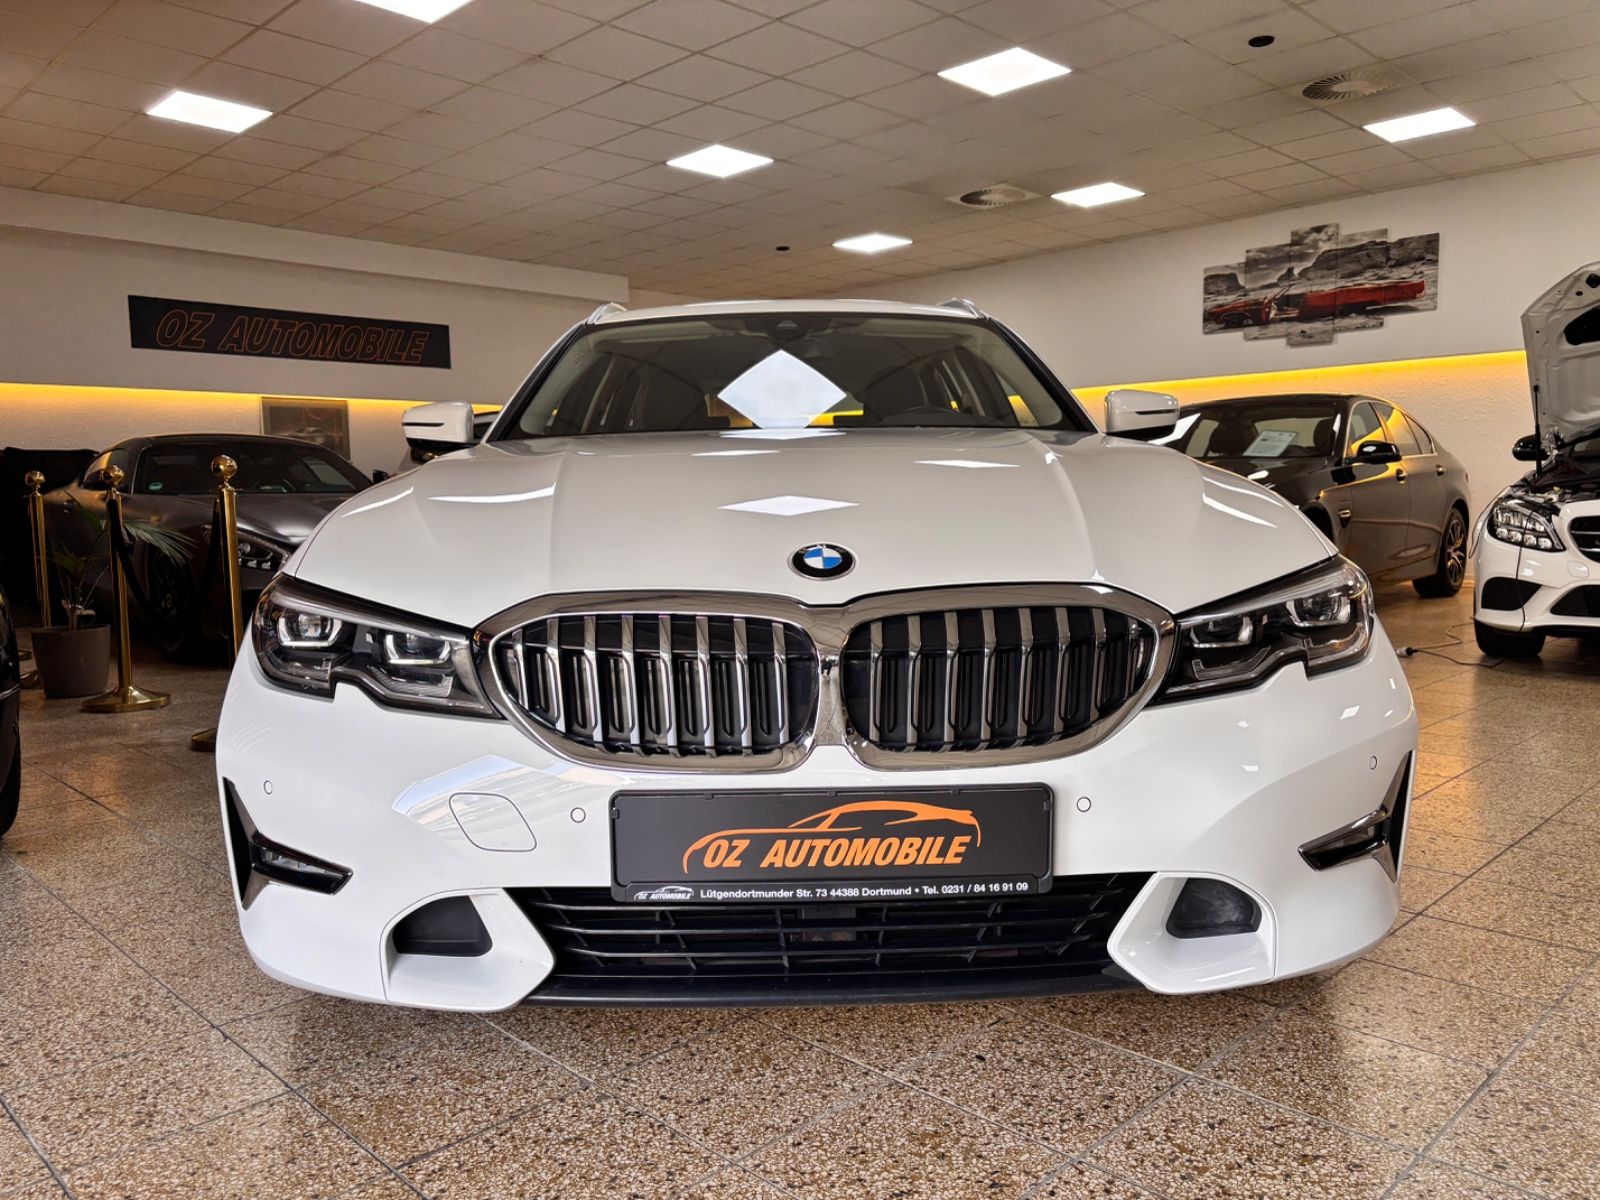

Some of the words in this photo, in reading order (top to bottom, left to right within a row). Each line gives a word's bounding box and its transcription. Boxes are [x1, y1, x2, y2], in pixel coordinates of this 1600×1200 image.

[156, 309, 215, 349] OZ
[217, 316, 430, 365] AUTOMOBILE
[703, 839, 751, 868] OZ
[760, 836, 972, 868] AUTOMOBILE
[649, 892, 692, 900] AUTOMOBILE
[700, 888, 793, 900] Lütgendortmunder
[796, 888, 813, 898] Str.
[815, 888, 828, 897] 73
[829, 888, 859, 897] 44388
[862, 887, 912, 897] Dortmund
[922, 885, 939, 895] Tel.
[941, 885, 964, 894] 0231
[973, 884, 986, 893] 84
[989, 883, 1000, 893] 16
[1002, 883, 1013, 892] 91
[1016, 882, 1029, 891] 09
